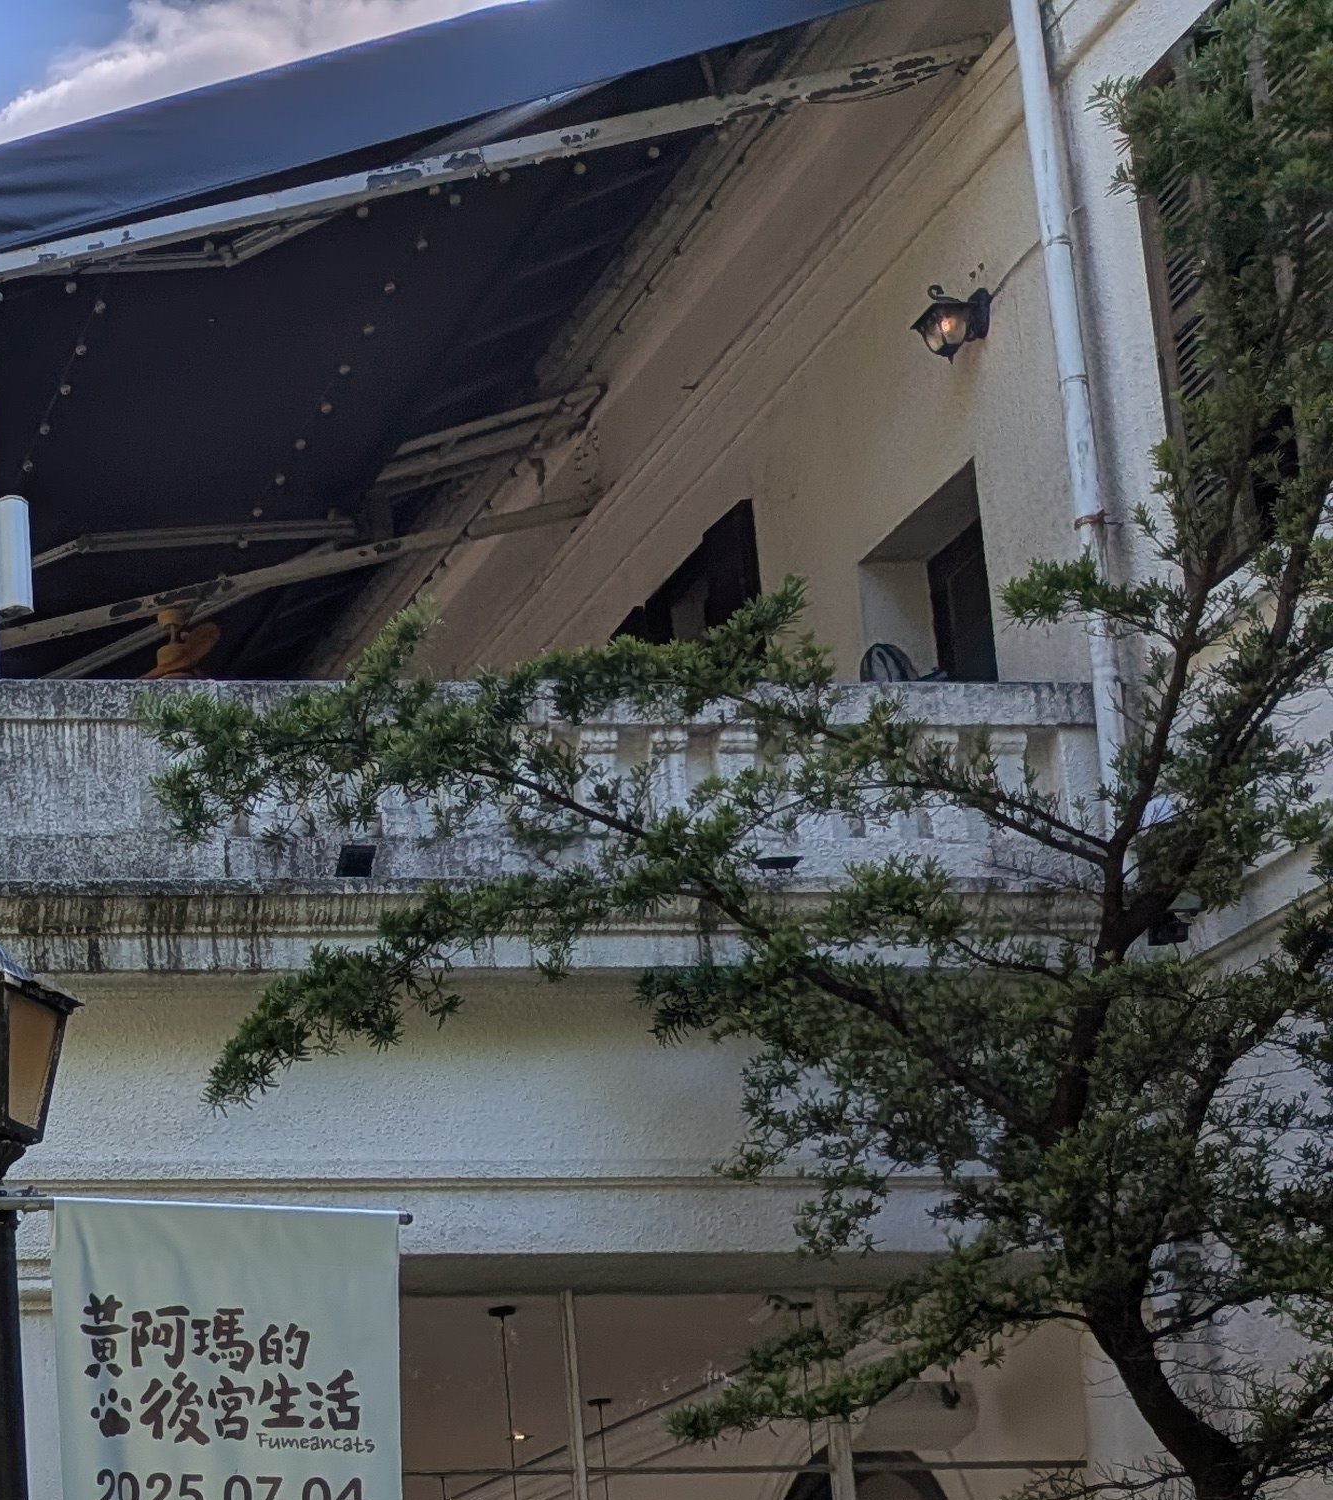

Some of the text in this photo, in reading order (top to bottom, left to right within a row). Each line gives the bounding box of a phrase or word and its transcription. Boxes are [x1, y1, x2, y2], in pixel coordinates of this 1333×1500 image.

[80, 1293, 310, 1378] 黃阿瑪的
[140, 1369, 360, 1445] 後宮生活
[256, 1433, 375, 1453] Fumeancats
